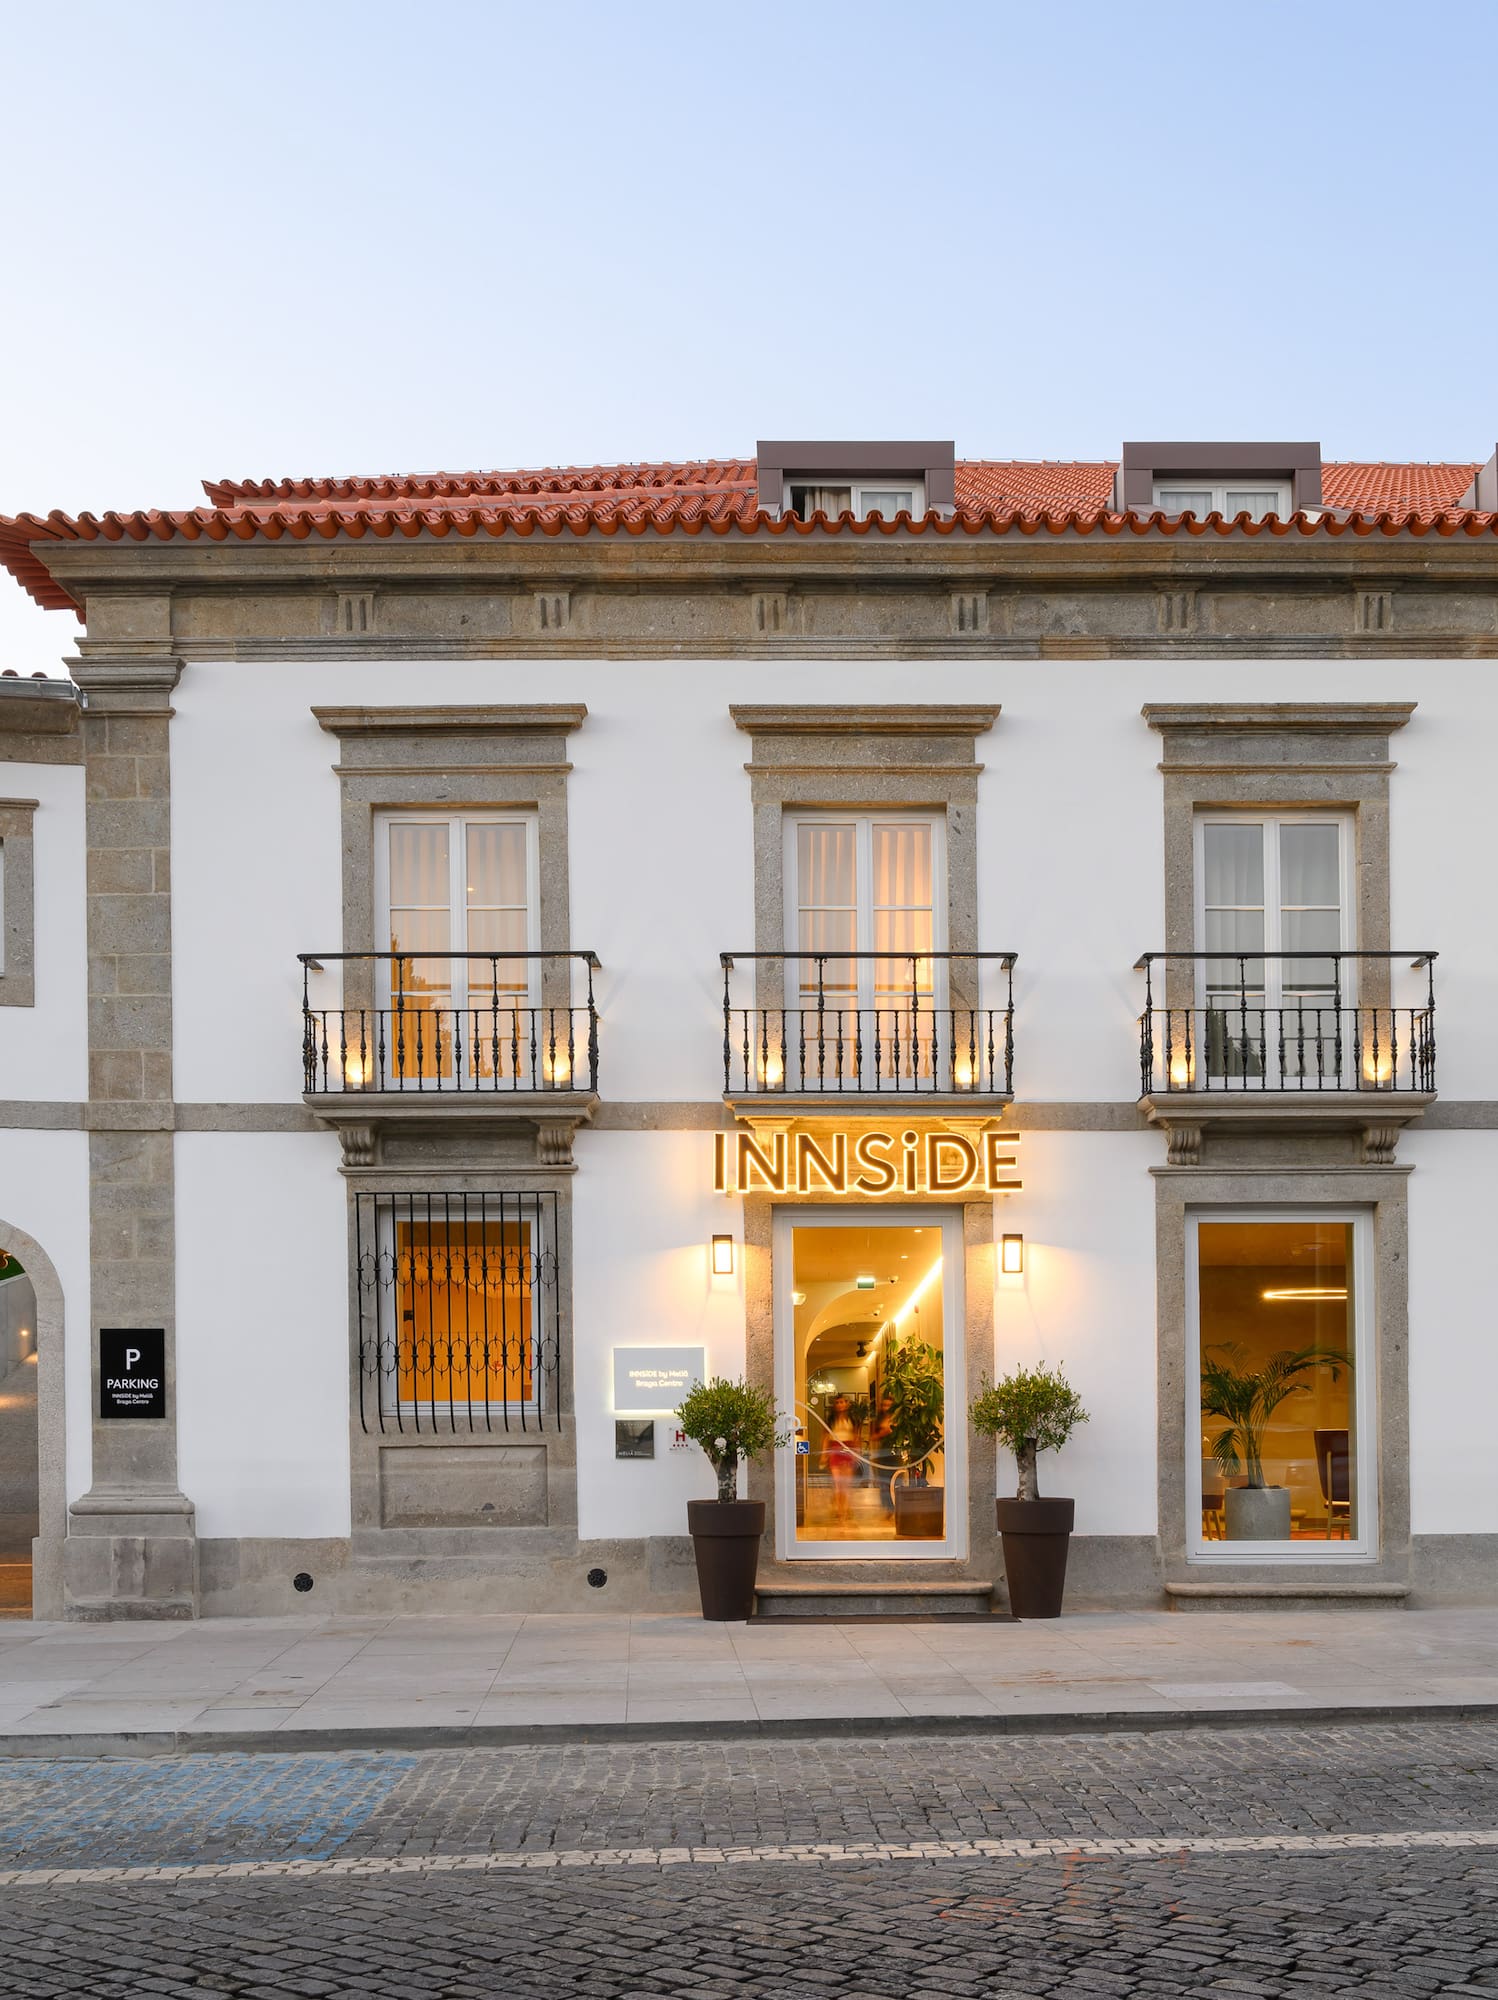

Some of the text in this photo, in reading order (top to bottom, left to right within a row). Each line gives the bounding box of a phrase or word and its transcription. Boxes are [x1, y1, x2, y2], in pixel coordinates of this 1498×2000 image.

[126, 1348, 141, 1371] P
[658, 1370, 668, 1379] by
[106, 1379, 159, 1389] PARKING
[636, 1380, 684, 1389] Braga Centro
[675, 1430, 686, 1442] H
